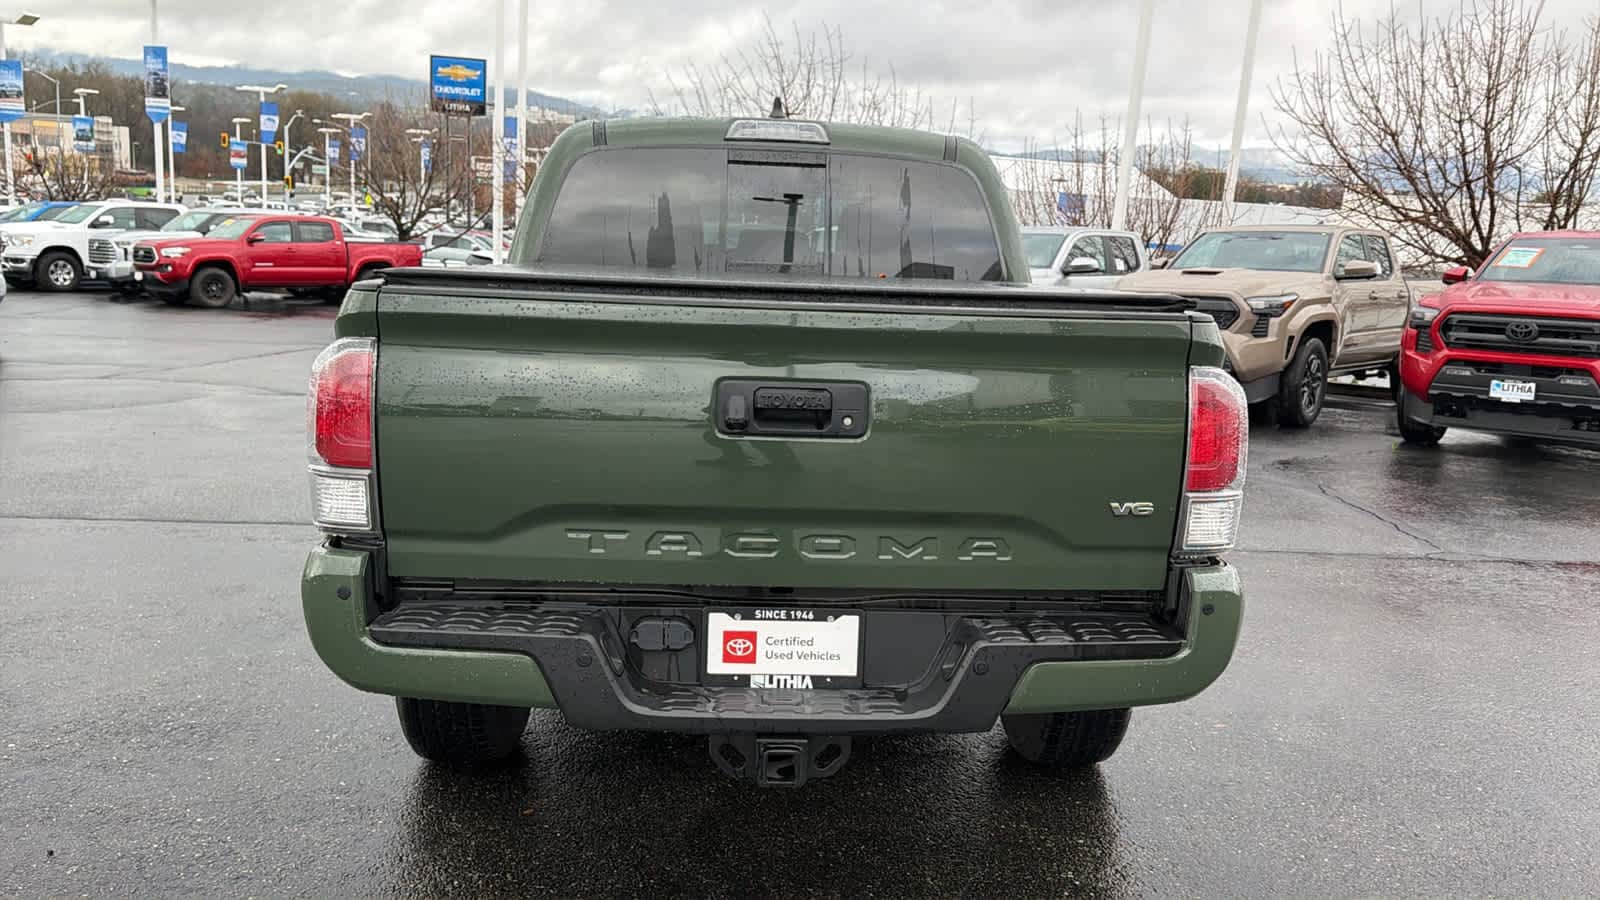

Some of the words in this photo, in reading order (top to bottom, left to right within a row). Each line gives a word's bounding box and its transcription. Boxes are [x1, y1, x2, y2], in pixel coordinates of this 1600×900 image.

[434, 85, 481, 96] CHEVROLET
[1502, 384, 1533, 393] LITHIA
[758, 391, 825, 408] TOYOTA
[1110, 502, 1154, 515] V6
[565, 528, 1012, 560] TACOMA
[755, 610, 787, 619] SINCE
[790, 610, 815, 620] 1946
[765, 636, 815, 647] Certified
[765, 651, 794, 660] Used
[796, 651, 841, 661] Vehicles
[765, 675, 814, 689] LITHIA
